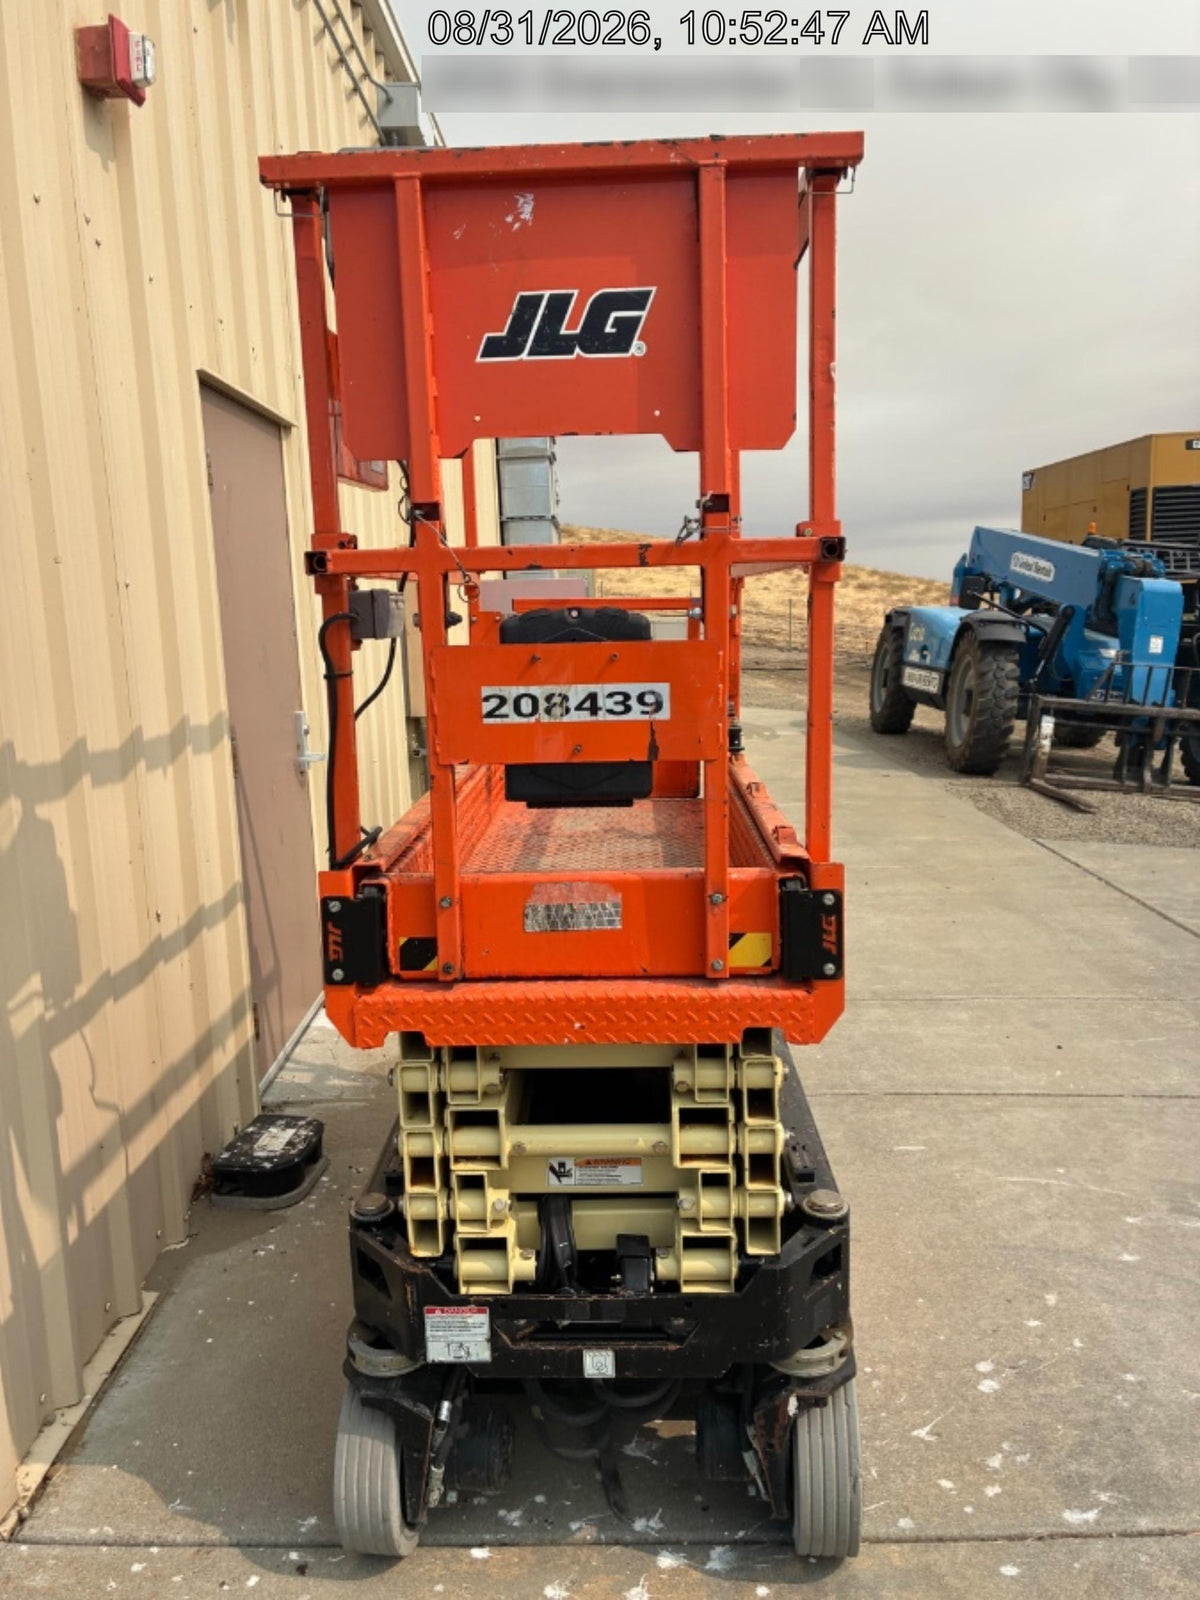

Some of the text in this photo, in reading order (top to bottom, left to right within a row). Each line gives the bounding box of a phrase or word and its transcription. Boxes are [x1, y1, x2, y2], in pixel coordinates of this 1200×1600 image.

[476, 286, 657, 363] JLG
[482, 690, 664, 718] 208439
[327, 921, 343, 962] JLG
[821, 913, 837, 956] JLG
